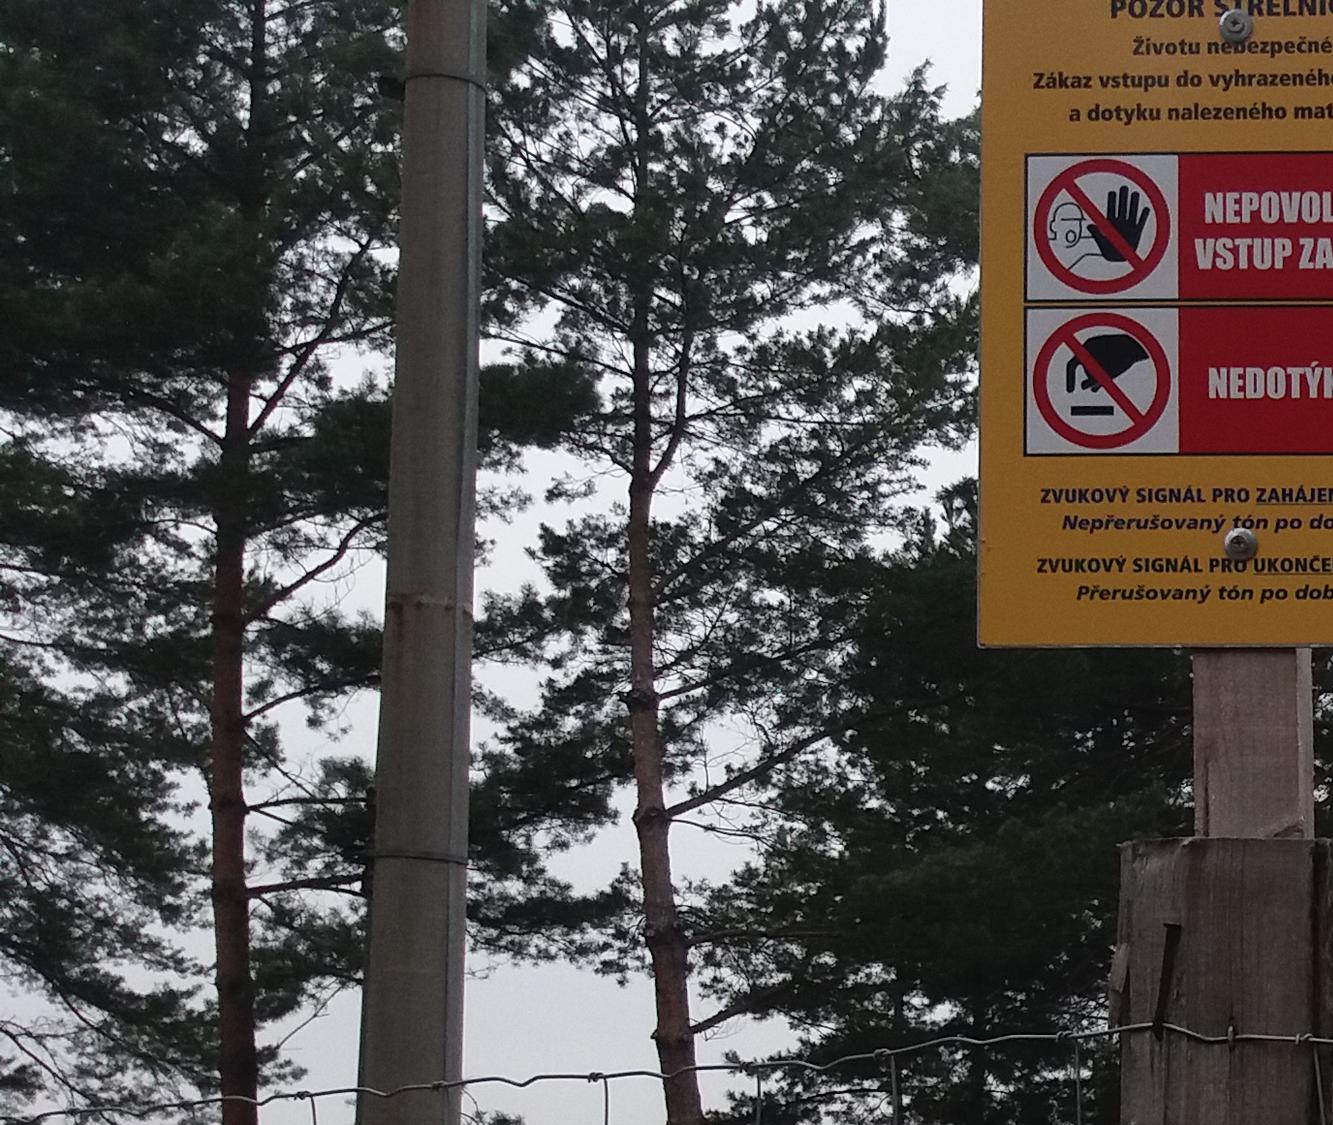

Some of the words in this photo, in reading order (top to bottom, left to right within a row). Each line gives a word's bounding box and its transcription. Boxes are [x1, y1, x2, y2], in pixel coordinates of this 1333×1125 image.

[1110, 0, 1204, 18] POZOR
[1132, 35, 1200, 56] Životu
[1033, 71, 1092, 90] Zákaz
[1099, 72, 1169, 92] vstupu
[1176, 70, 1202, 88] do
[1069, 109, 1080, 122] a
[1087, 104, 1161, 124] dotyku
[1168, 102, 1287, 121] nalezeného
[1195, 238, 1292, 270] VSTUP
[1040, 486, 1130, 503] ZVUKOVÝ
[1136, 485, 1206, 503] SIGNÁL
[1212, 488, 1250, 502] PRO
[1062, 515, 1226, 534] Nepřerušovaný
[1232, 515, 1268, 530] tón
[1274, 518, 1303, 533] po
[1037, 555, 1127, 573] ZVUKOVÝ
[1133, 556, 1203, 573] SIGNÁL
[1209, 558, 1247, 573] PRO
[1076, 585, 1211, 604] Přerušovaný
[1218, 585, 1254, 601] tón
[1260, 588, 1288, 604] po
